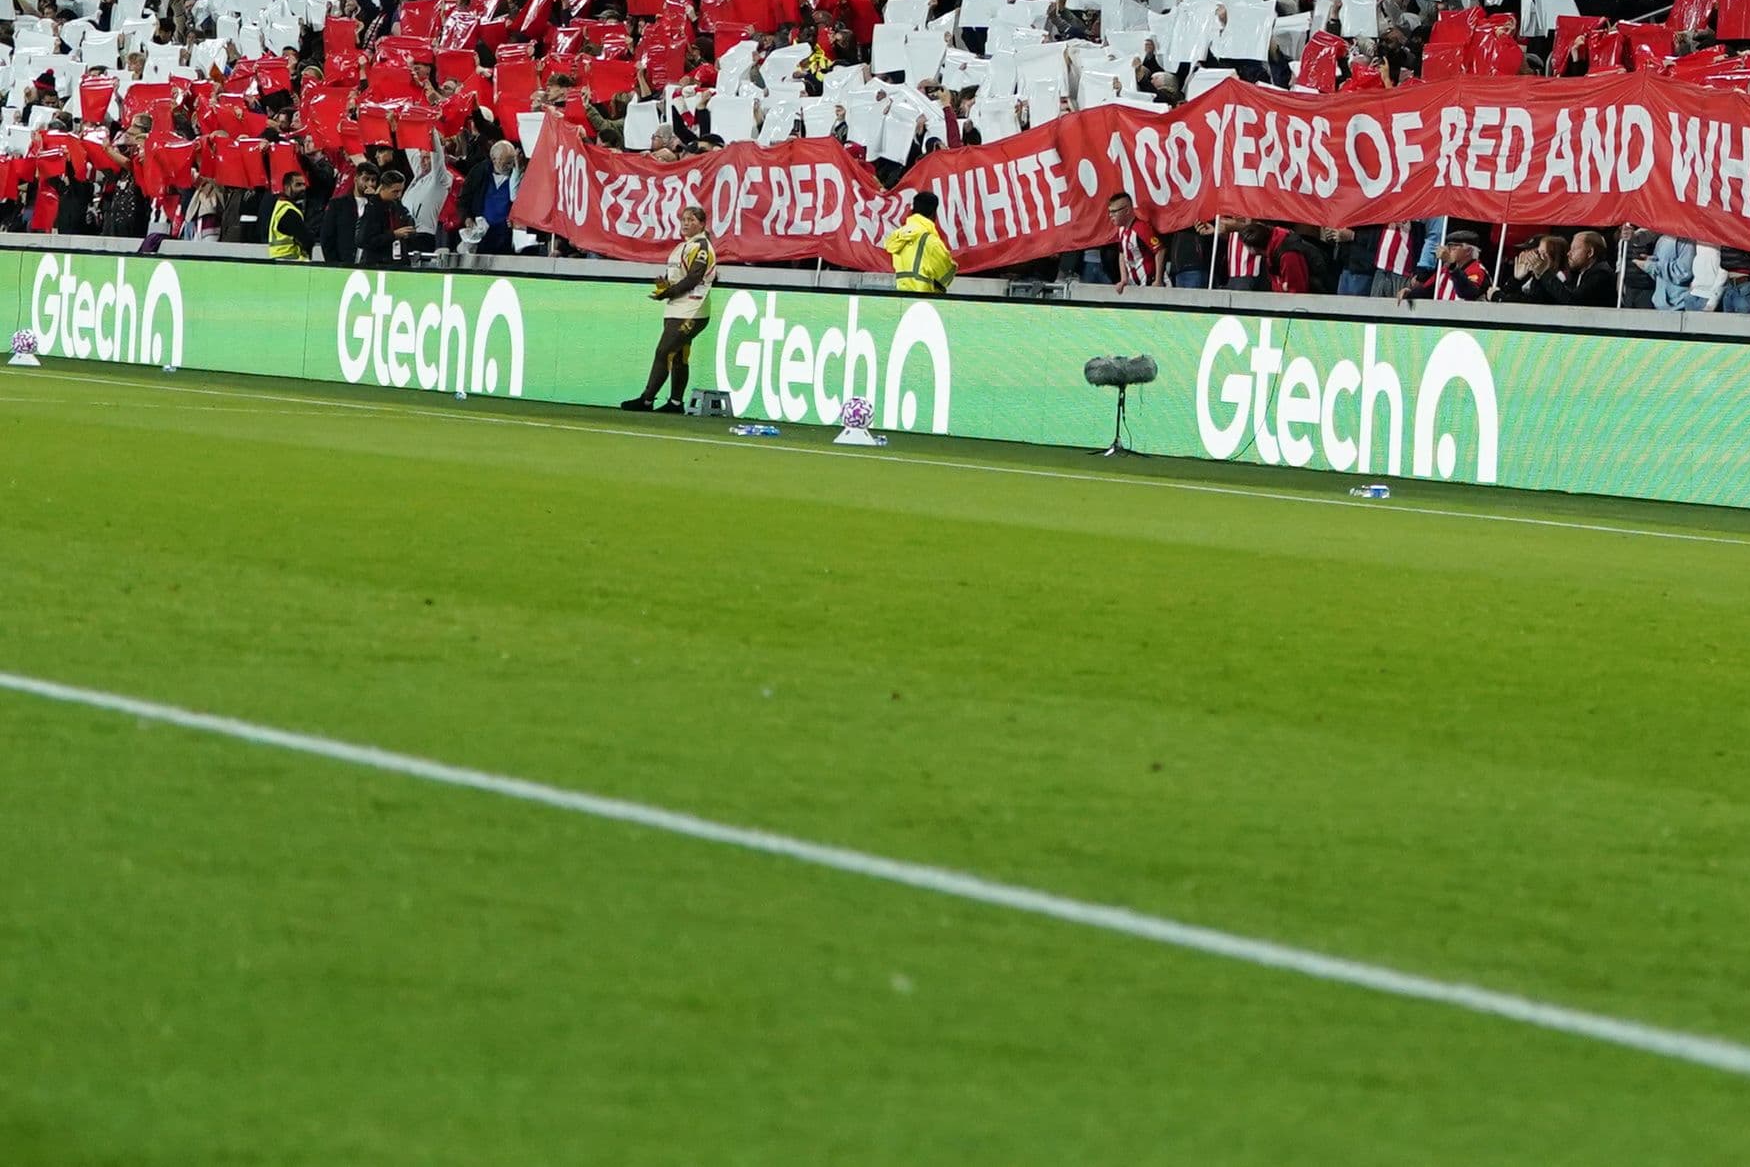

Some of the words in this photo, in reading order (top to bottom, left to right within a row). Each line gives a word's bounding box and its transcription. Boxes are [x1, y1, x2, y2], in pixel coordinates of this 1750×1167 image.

[555, 145, 588, 226] 100
[712, 164, 764, 238] OF
[769, 163, 845, 237] RED
[931, 149, 1072, 245] WHITE
[1107, 121, 1202, 208] 100
[1205, 104, 1339, 198] YEARS
[1345, 111, 1424, 198] OF
[1434, 105, 1534, 191] RED
[1539, 104, 1654, 194] AND
[32, 253, 137, 362] Gtech
[337, 270, 467, 391] Gtech
[716, 290, 877, 425] Gtech
[1196, 315, 1404, 476] Gtech
